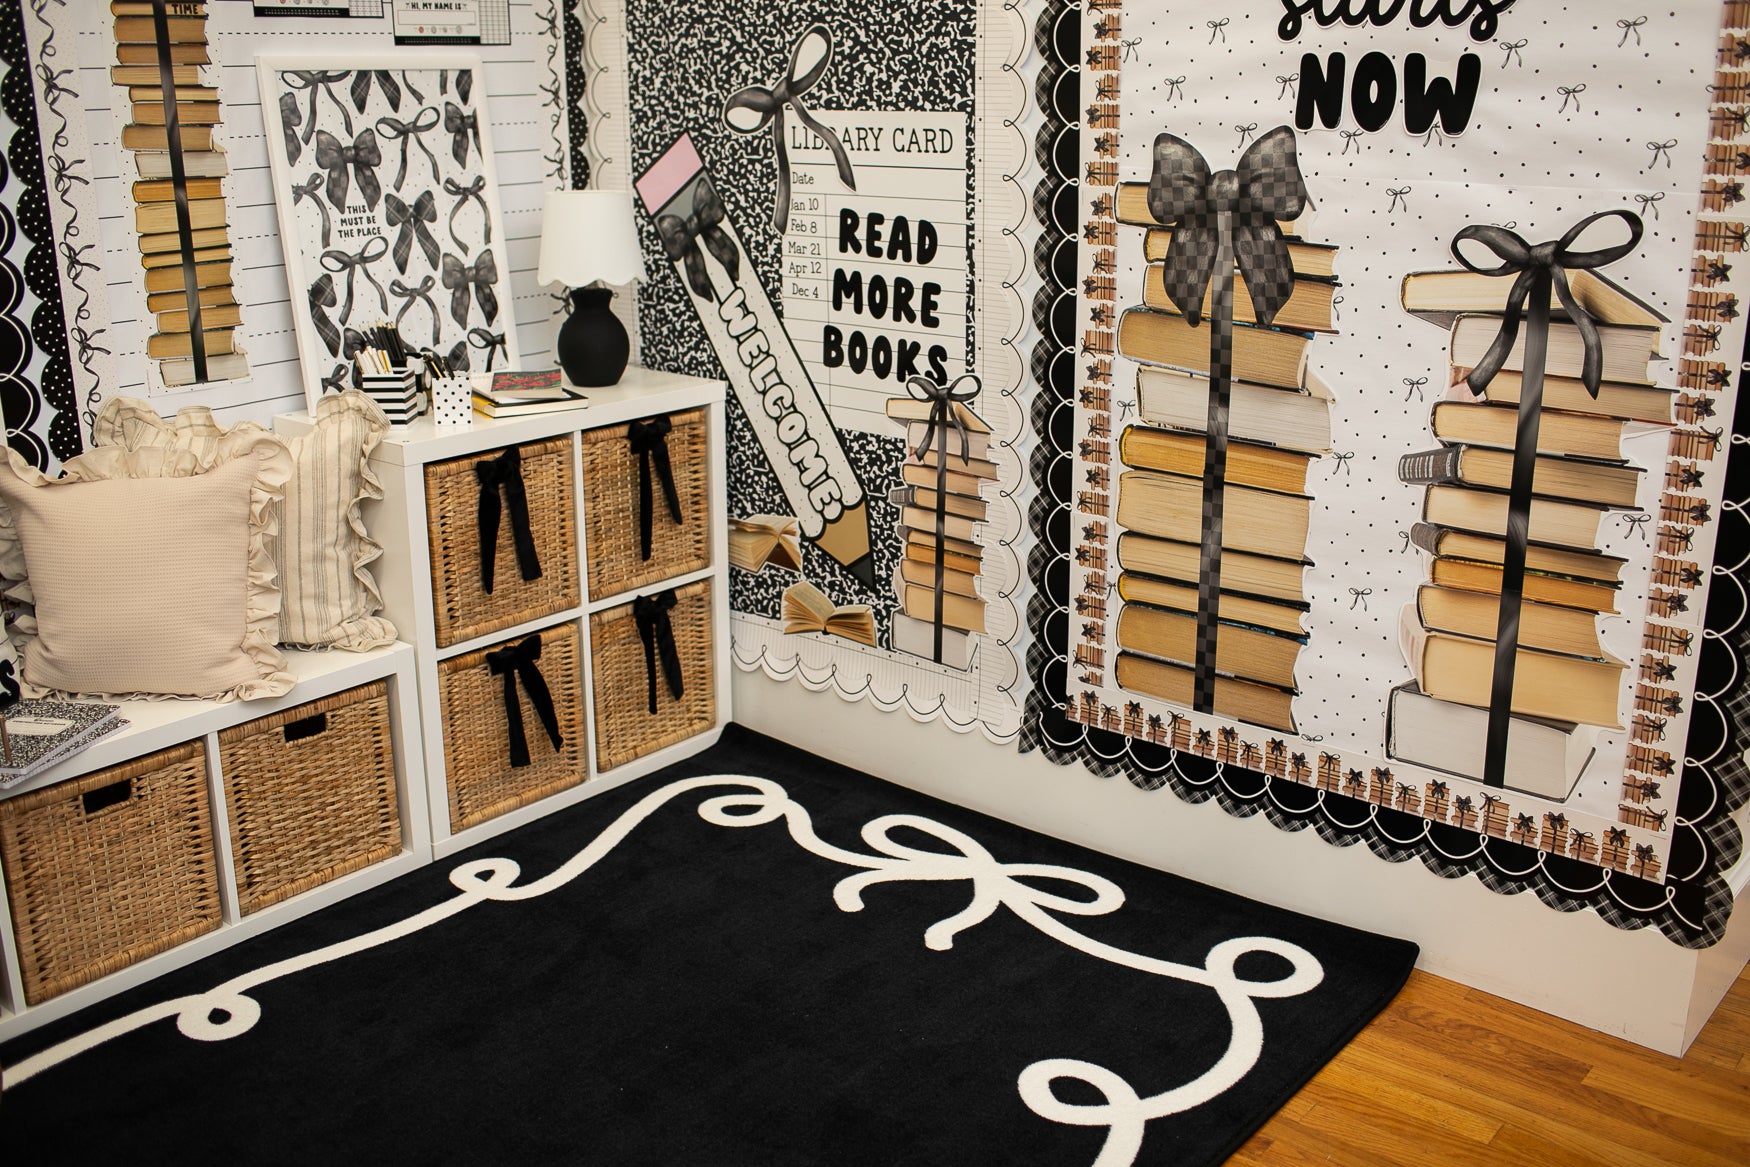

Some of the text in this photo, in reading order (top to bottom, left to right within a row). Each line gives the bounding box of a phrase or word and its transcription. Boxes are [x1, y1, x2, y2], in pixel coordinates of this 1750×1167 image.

[171, 3, 198, 15] TIME
[422, 2, 432, 10] MY
[434, 2, 453, 10] NAME
[1295, 51, 1482, 134] NOW
[791, 126, 953, 154] LIBARY CARD
[792, 172, 815, 185] Date
[346, 204, 367, 214] THIS
[791, 198, 819, 211] Jan 10
[340, 215, 376, 226] MUST BE
[790, 219, 818, 233] Feb 8
[338, 226, 381, 238] THE PLACE
[838, 208, 938, 265] READ
[788, 241, 821, 256] Mar 21
[788, 261, 822, 277] Apr 12
[792, 283, 819, 299] Dec 4
[832, 268, 941, 328] MORE
[823, 324, 948, 387] BOOKS
[718, 287, 843, 516] WELCOME
